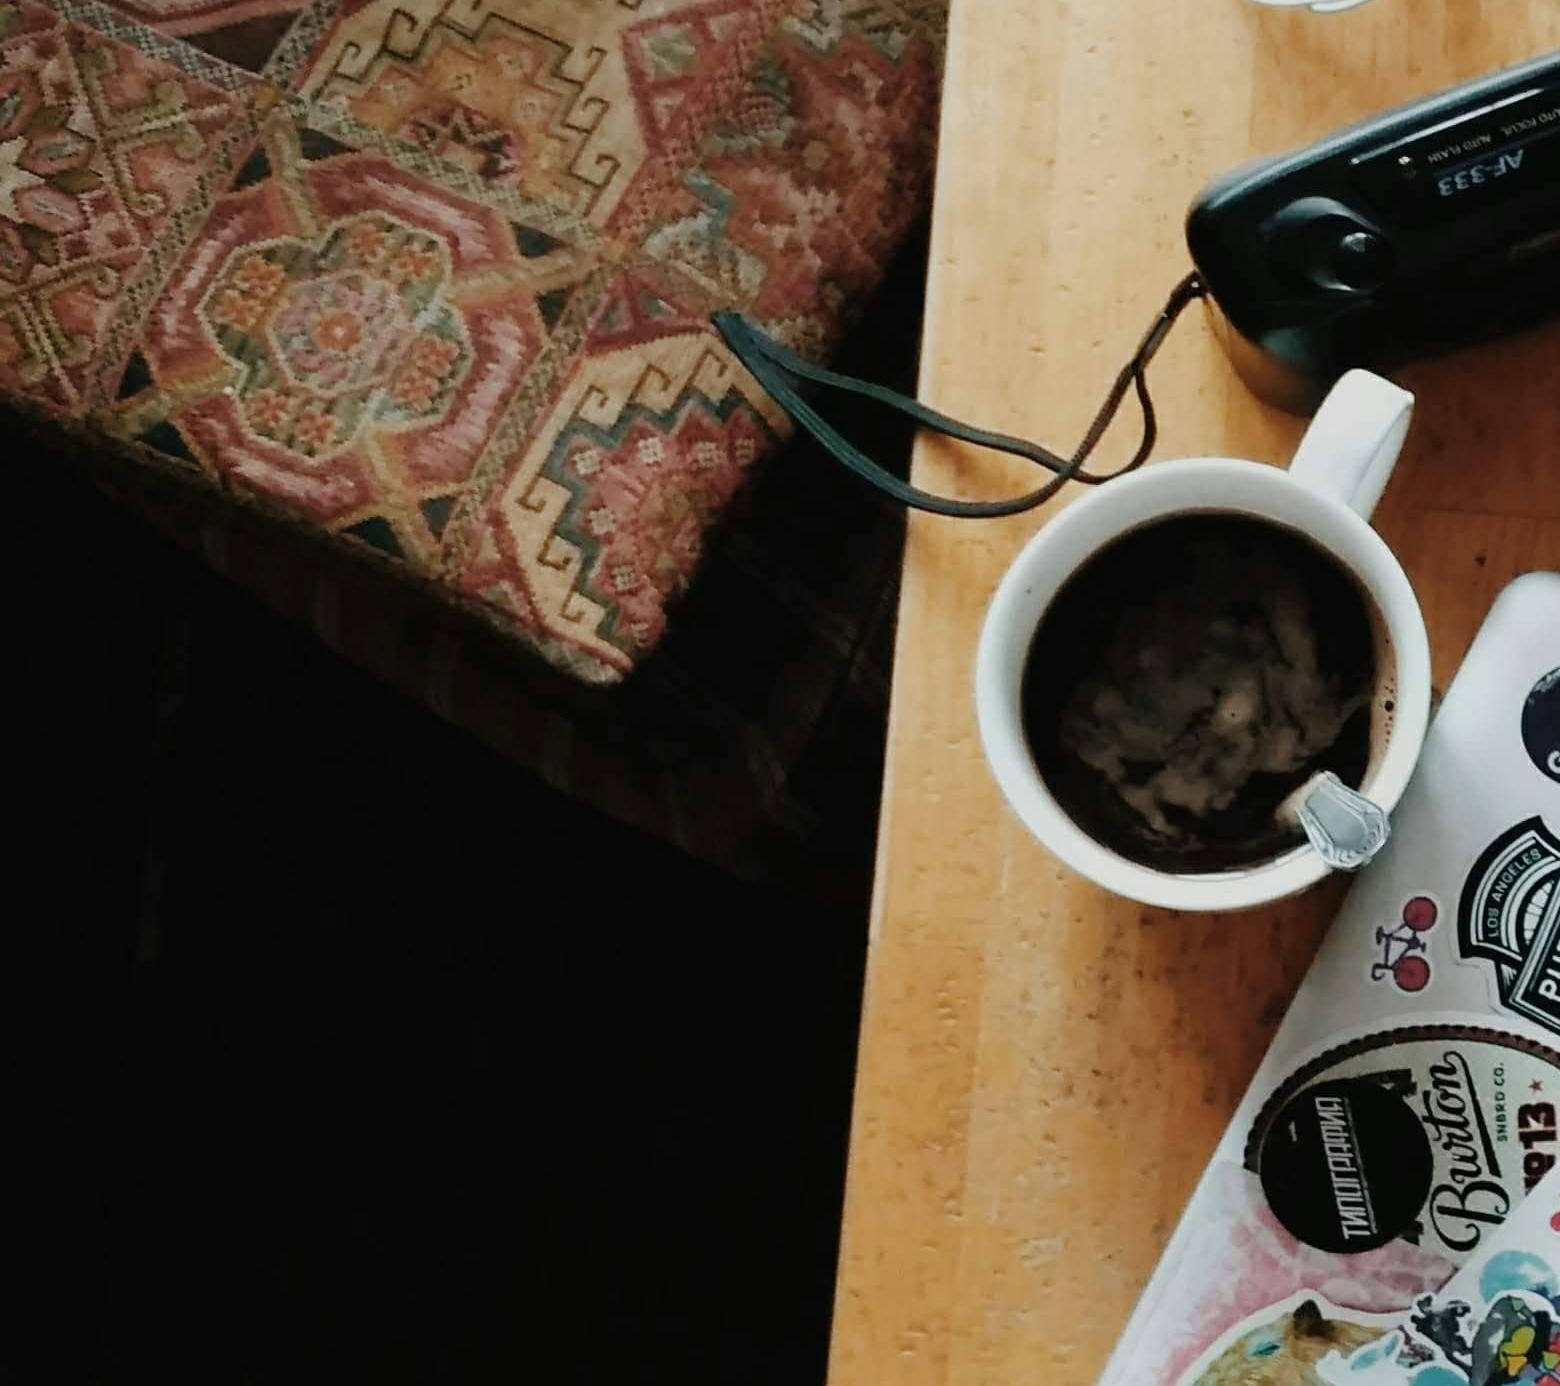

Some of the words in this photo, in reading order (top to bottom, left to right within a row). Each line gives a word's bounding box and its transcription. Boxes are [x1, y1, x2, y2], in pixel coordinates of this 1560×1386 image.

[1461, 133, 1491, 150] AUTO
[1439, 150, 1523, 195] AF-333
[1492, 844, 1541, 901] ANGELES
[1487, 908, 1499, 937] LOS
[1495, 1063, 1505, 1086] CO.
[1496, 1092, 1507, 1141] SNBRD
[1316, 1098, 1368, 1237] ТИПОГРАФИЯ
[1431, 1050, 1511, 1253] Burton
